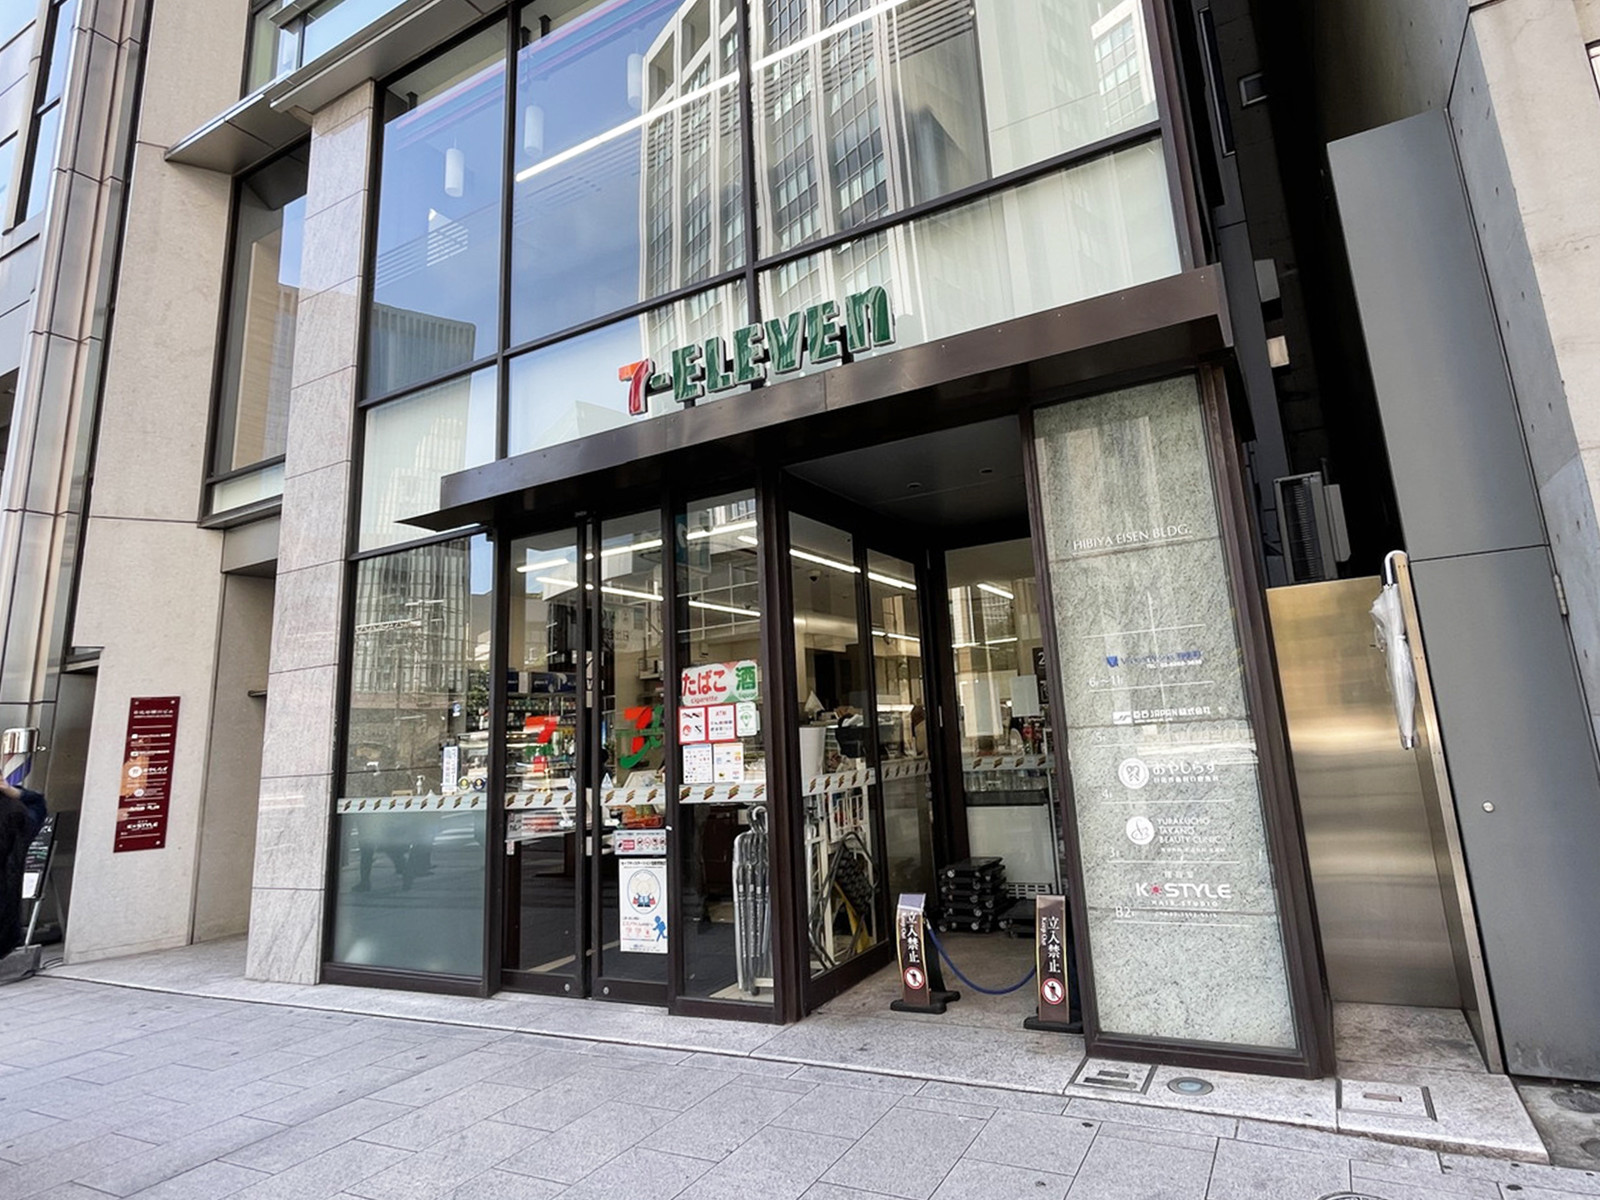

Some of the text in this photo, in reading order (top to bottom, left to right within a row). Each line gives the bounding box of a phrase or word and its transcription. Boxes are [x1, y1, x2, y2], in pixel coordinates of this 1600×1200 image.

[1072, 523, 1193, 550] HIBIYA EISEN BLDG.
[682, 665, 756, 697] たばこ 酒
[906, 911, 920, 963] 立入禁止
[1048, 916, 1061, 973] 立入禁止
